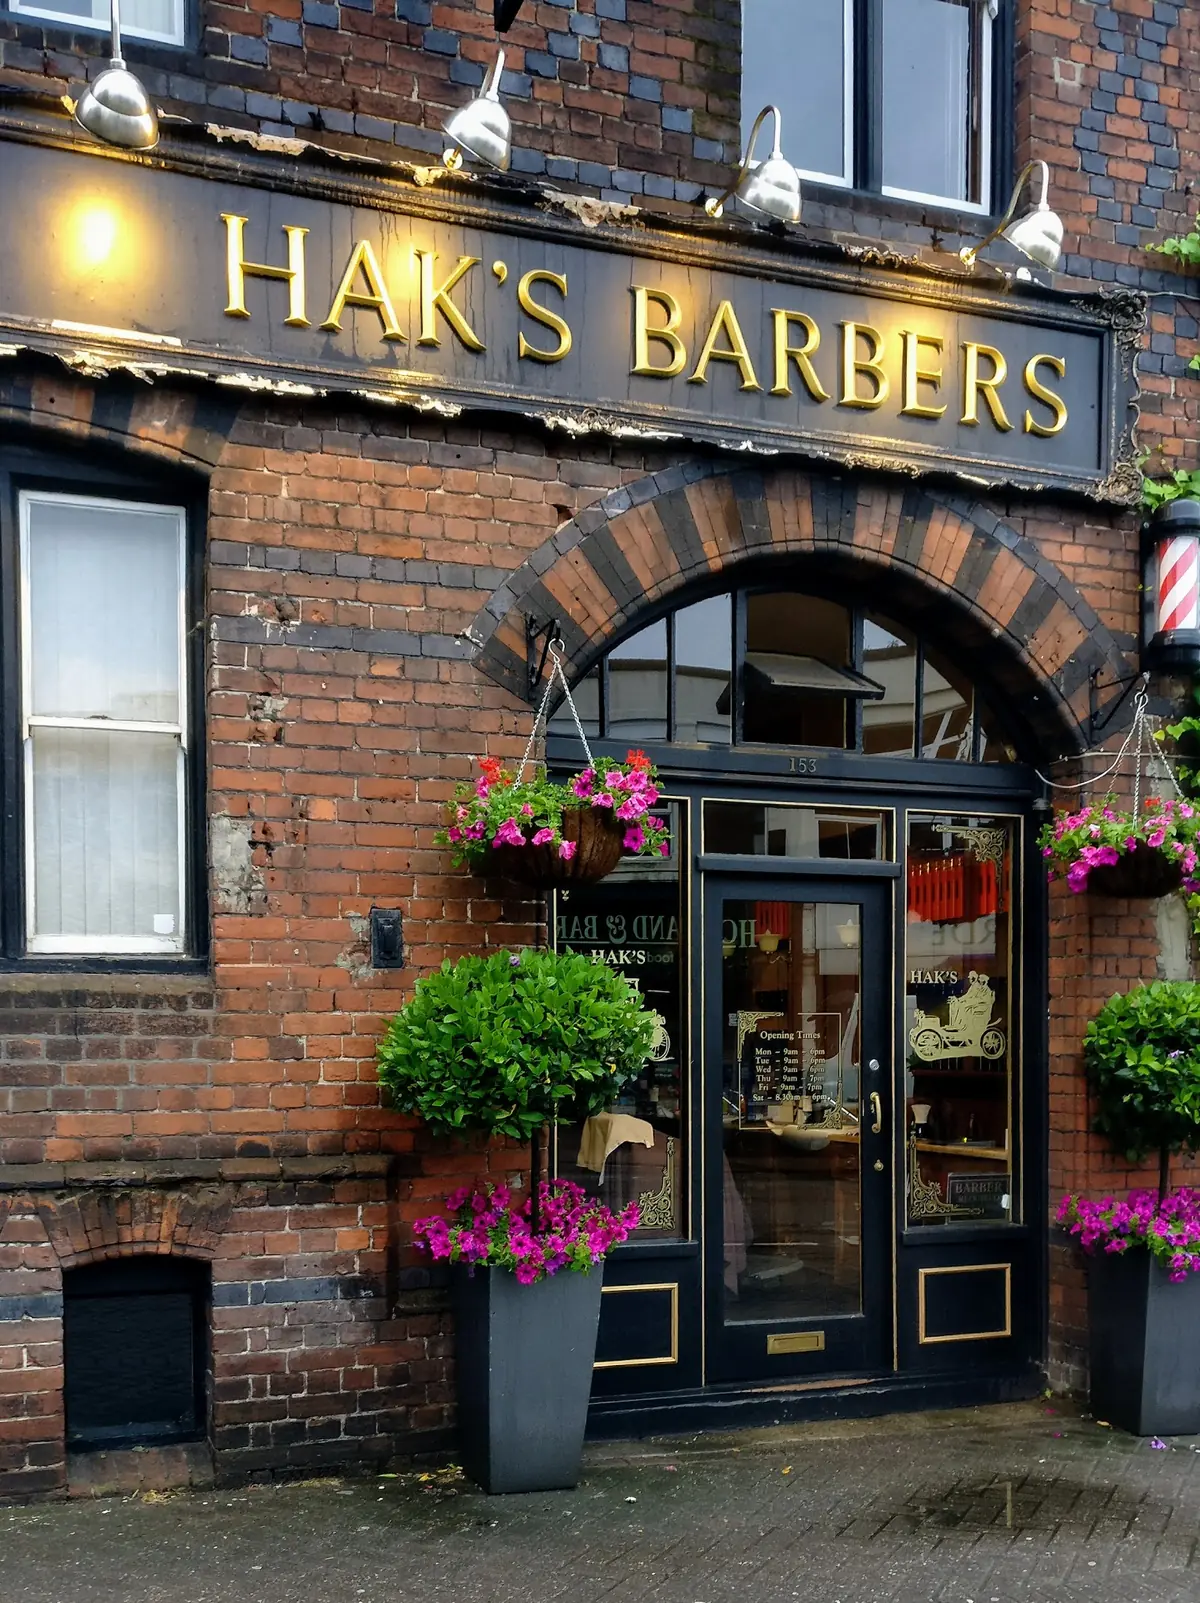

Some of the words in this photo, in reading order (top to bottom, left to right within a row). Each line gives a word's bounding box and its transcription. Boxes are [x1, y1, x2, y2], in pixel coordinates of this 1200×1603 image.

[220, 212, 572, 363] HAK'S
[630, 285, 1068, 437] BARBERS
[789, 757, 817, 773] 153
[591, 949, 646, 965] HAK'S
[910, 970, 958, 984] HAK'S
[760, 1031, 794, 1040] Opening
[796, 1031, 820, 1039] Times
[756, 1048, 772, 1056] Mon
[784, 1048, 798, 1056] 9am
[755, 1056, 769, 1064] Tue
[784, 1056, 798, 1064] 9am
[756, 1065, 771, 1073] Wed
[783, 1065, 798, 1073] 9am
[756, 1074, 771, 1082] Thu
[782, 1074, 798, 1082] 9am
[758, 1083, 768, 1091] Fri
[780, 1083, 795, 1091] 9am
